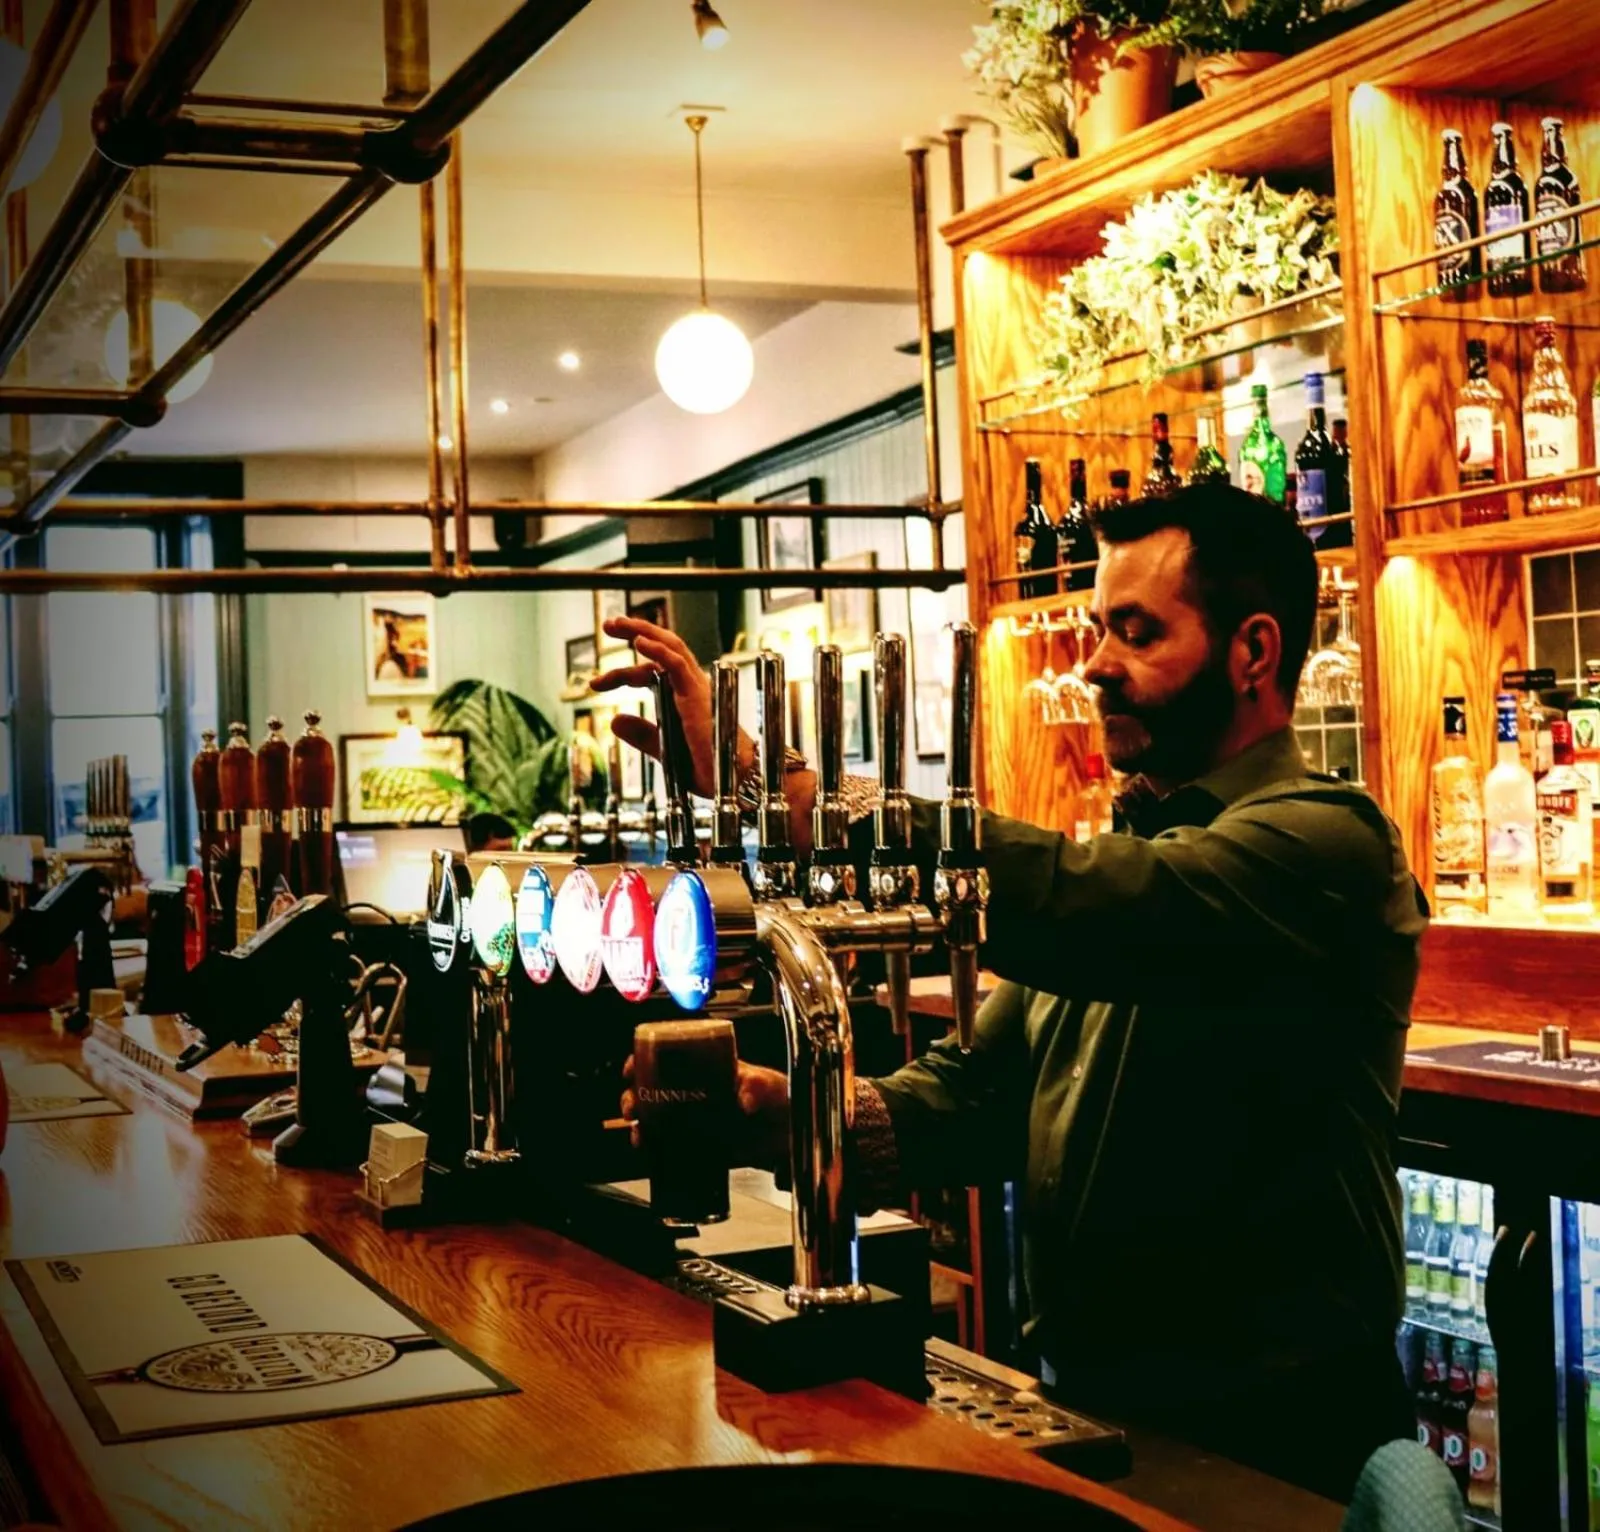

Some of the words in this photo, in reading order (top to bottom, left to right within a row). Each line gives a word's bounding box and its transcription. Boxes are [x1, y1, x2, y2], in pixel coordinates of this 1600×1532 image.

[638, 1086, 708, 1104] GUINNESS
[166, 1273, 226, 1289] GO
[180, 1289, 268, 1334] BEYOND
[227, 1336, 316, 1388] HORIZON
